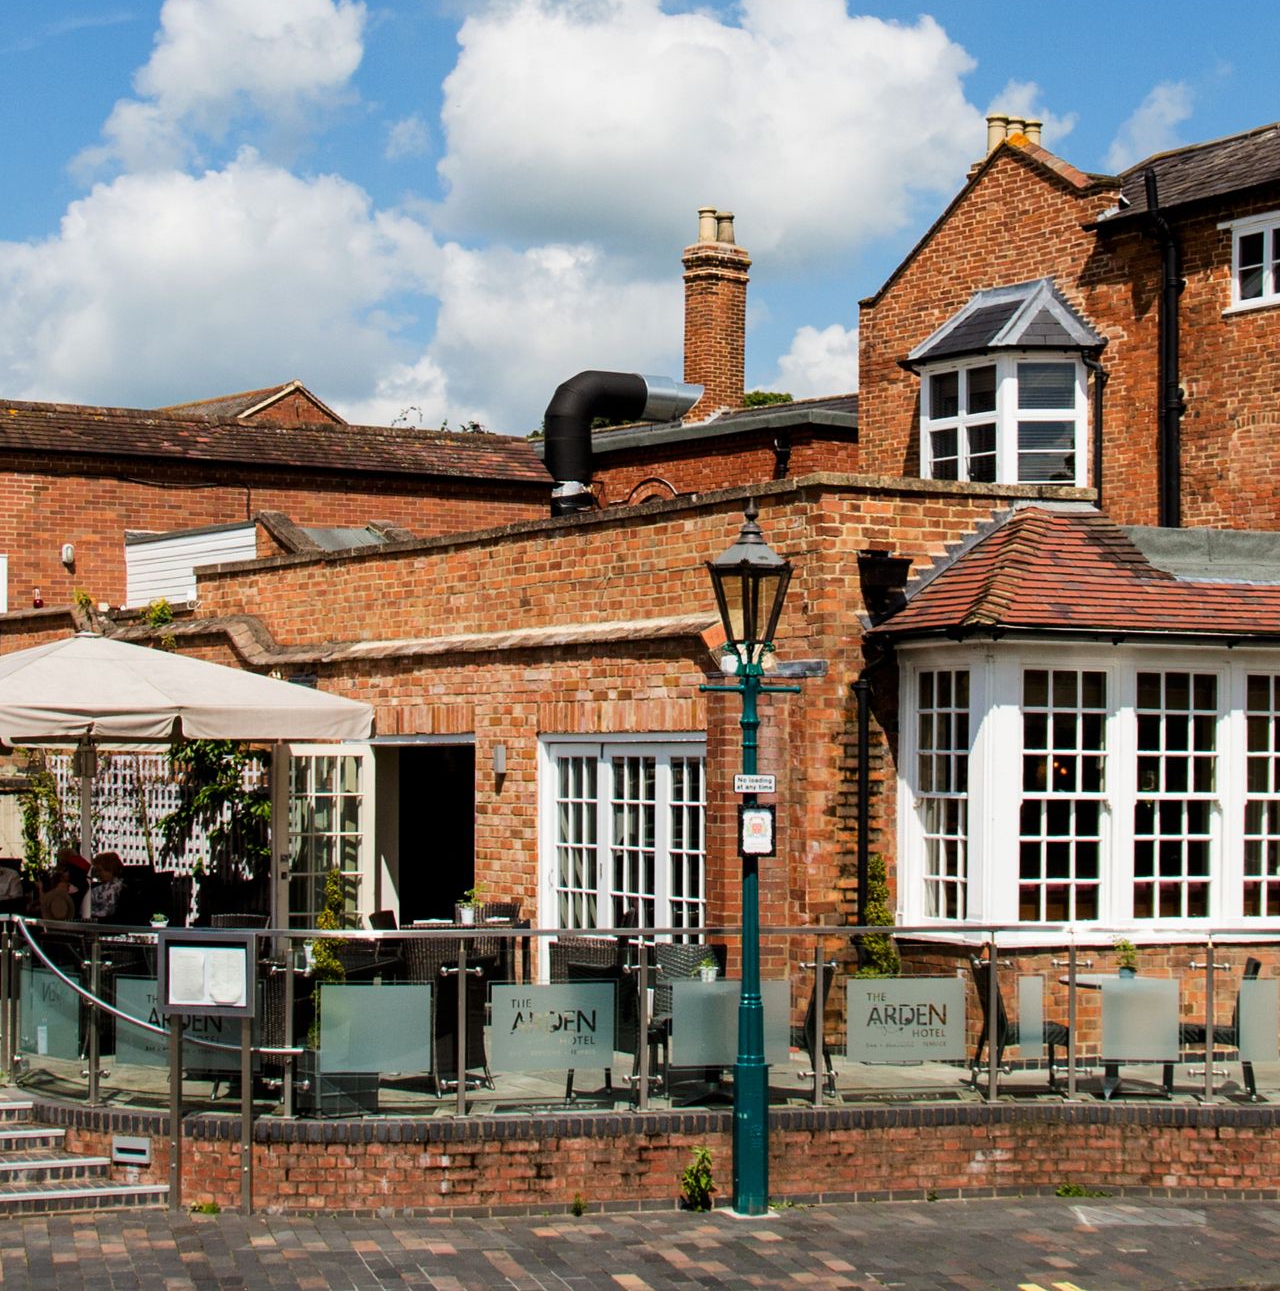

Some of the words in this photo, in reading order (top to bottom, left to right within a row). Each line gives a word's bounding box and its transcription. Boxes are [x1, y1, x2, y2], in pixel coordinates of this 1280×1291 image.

[866, 992, 886, 1001] THE
[511, 999, 532, 1008] THE
[866, 1004, 947, 1026] ARDEN
[912, 1028, 946, 1038] HOTEL
